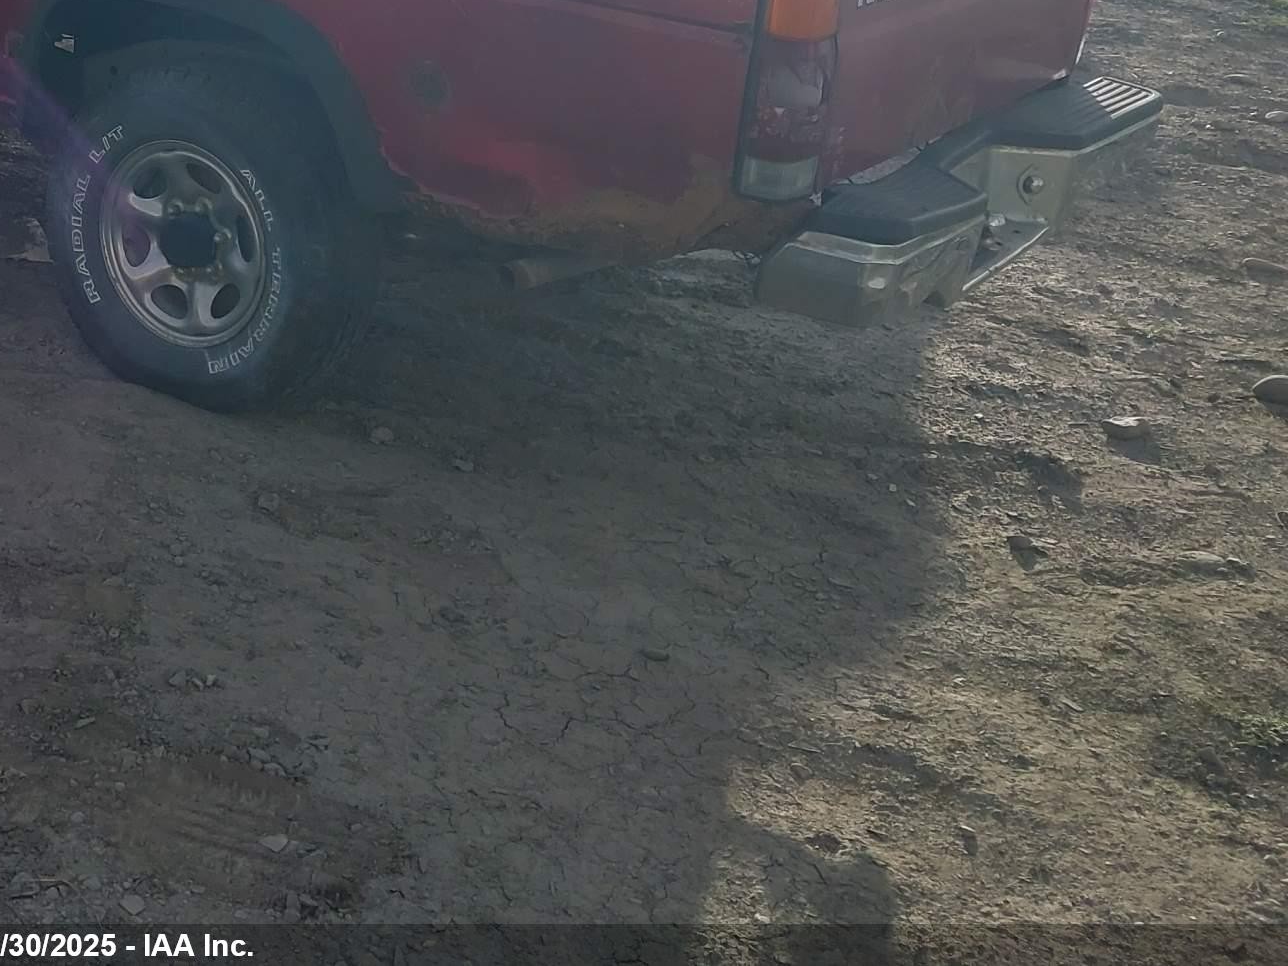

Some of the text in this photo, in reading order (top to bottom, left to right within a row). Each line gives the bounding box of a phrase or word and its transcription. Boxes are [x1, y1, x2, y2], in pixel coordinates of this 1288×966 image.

[71, 124, 123, 304] RADIAL L/T
[240, 168, 274, 233] ALL
